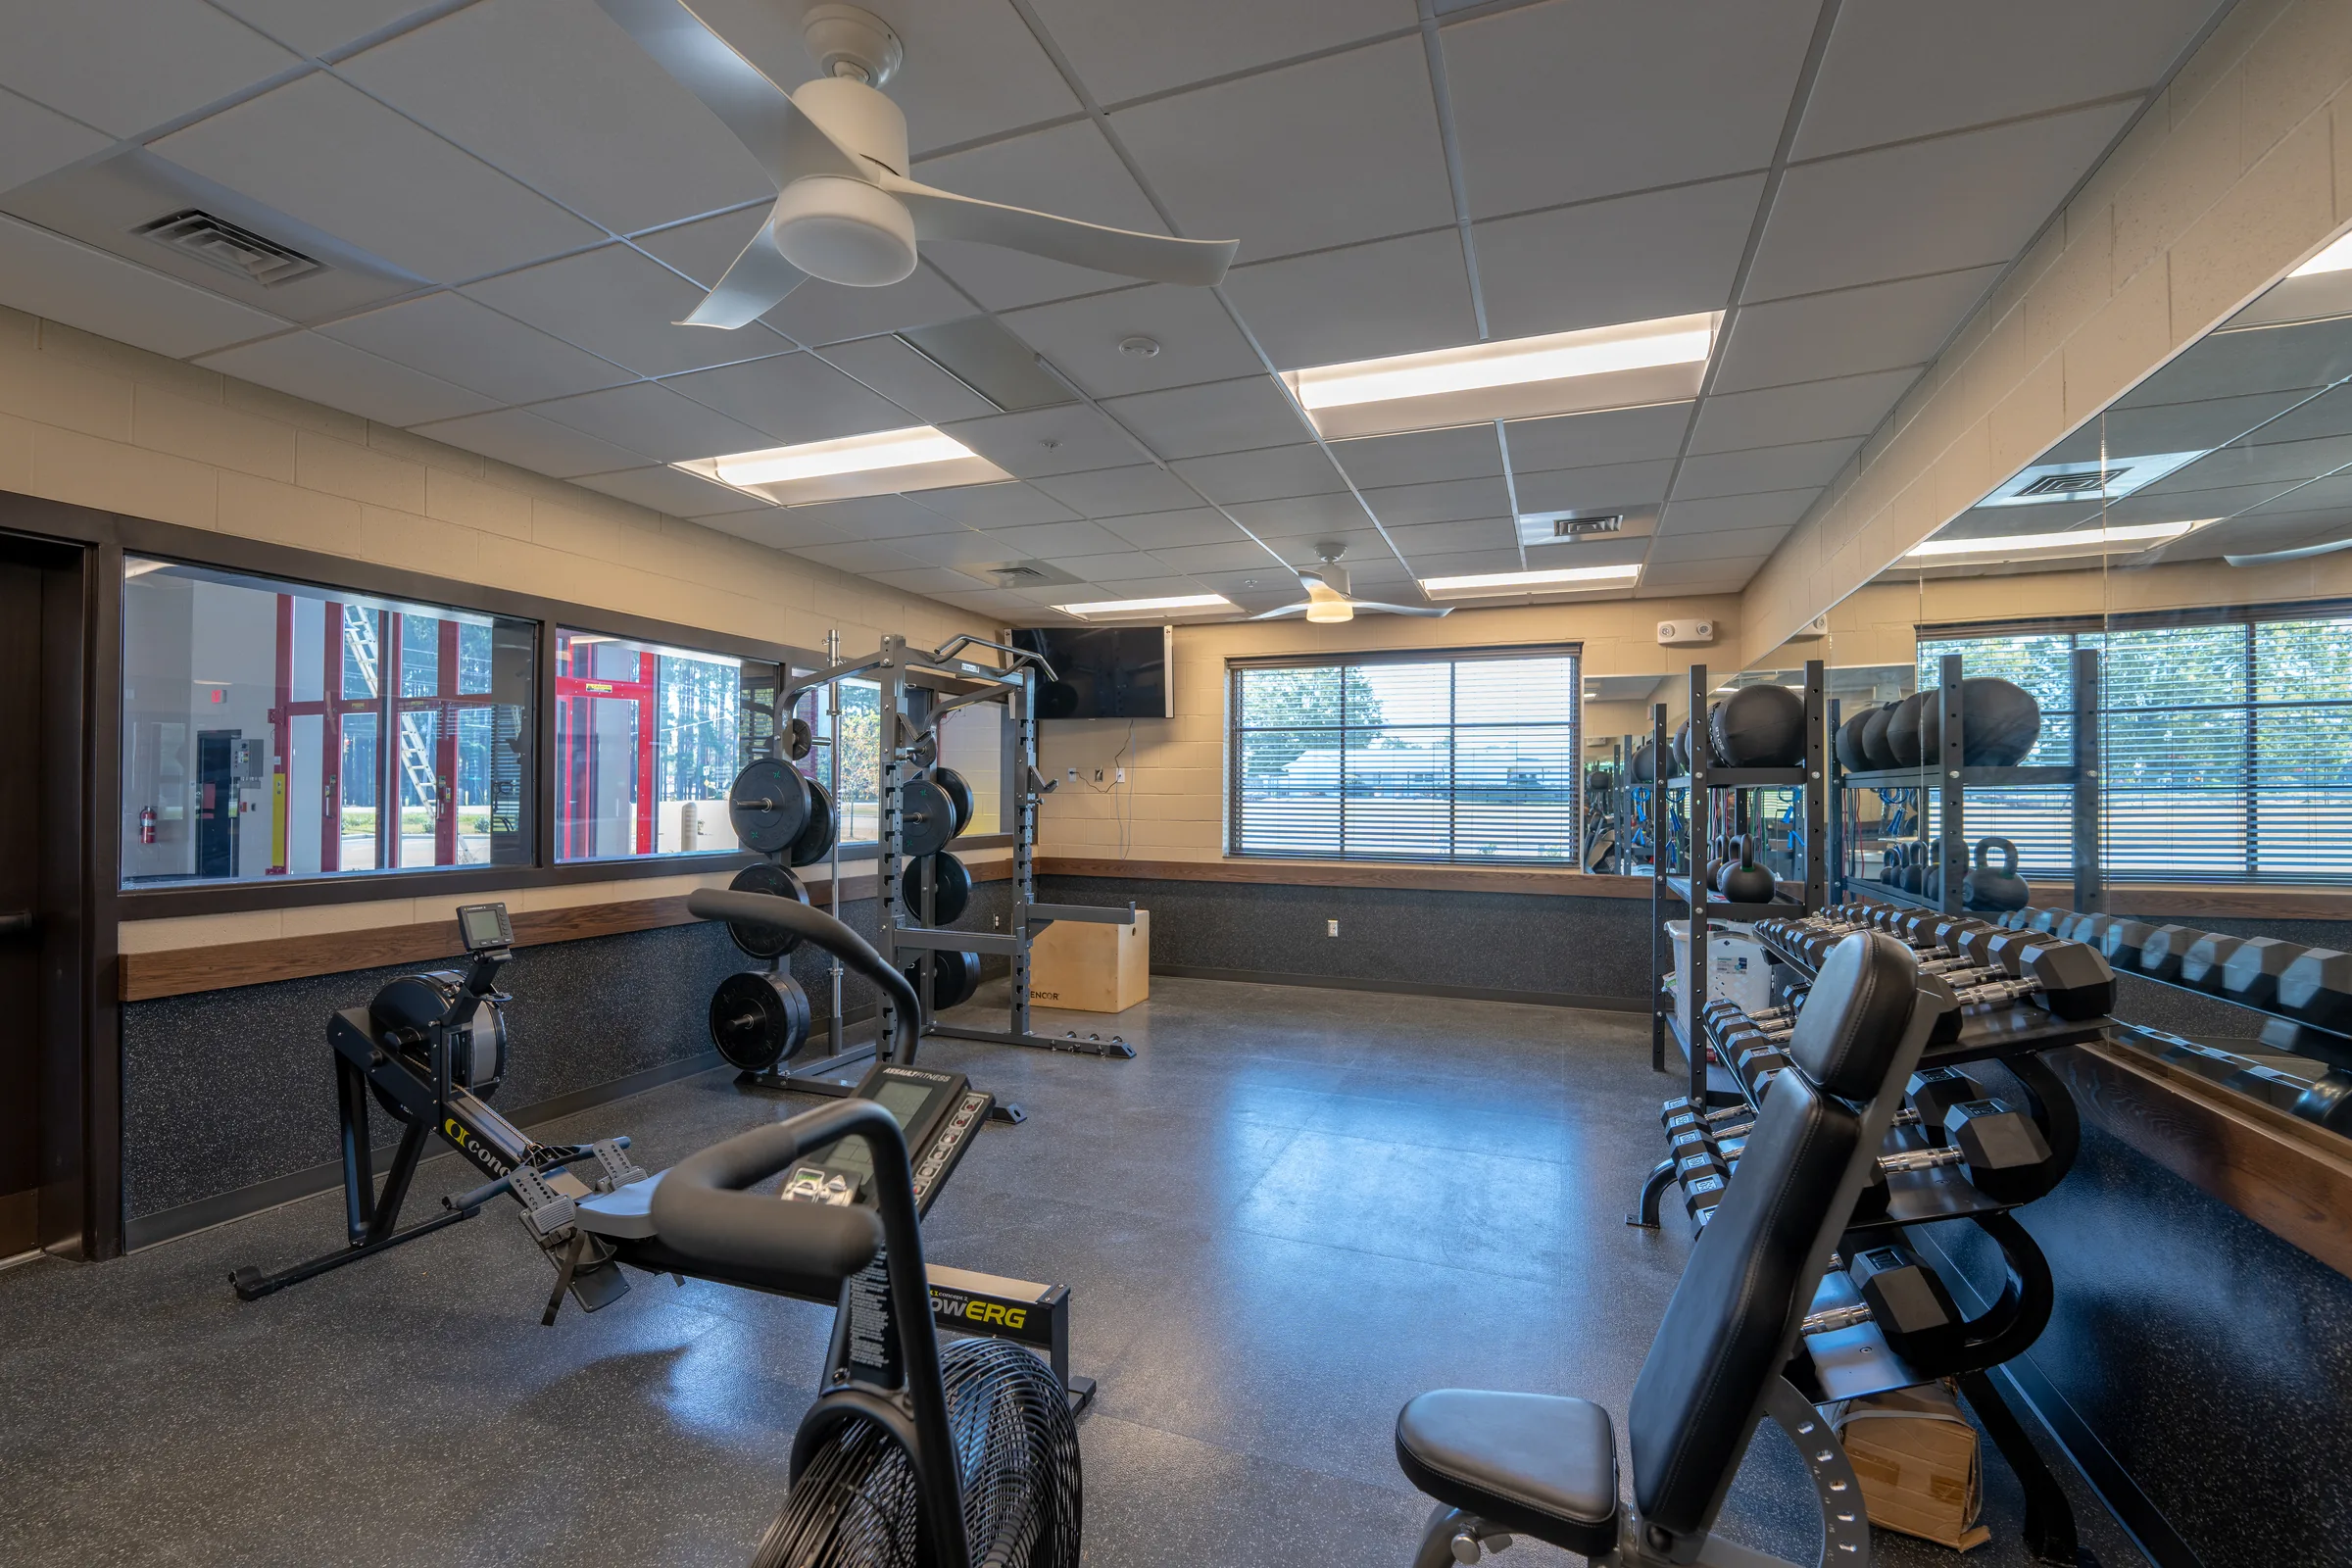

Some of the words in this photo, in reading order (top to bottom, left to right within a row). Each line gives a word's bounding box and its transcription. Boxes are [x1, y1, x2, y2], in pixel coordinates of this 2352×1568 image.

[1030, 991, 1058, 1001] ENCOR
[468, 1140, 512, 1178] conc
[938, 1292, 963, 1301] concept
